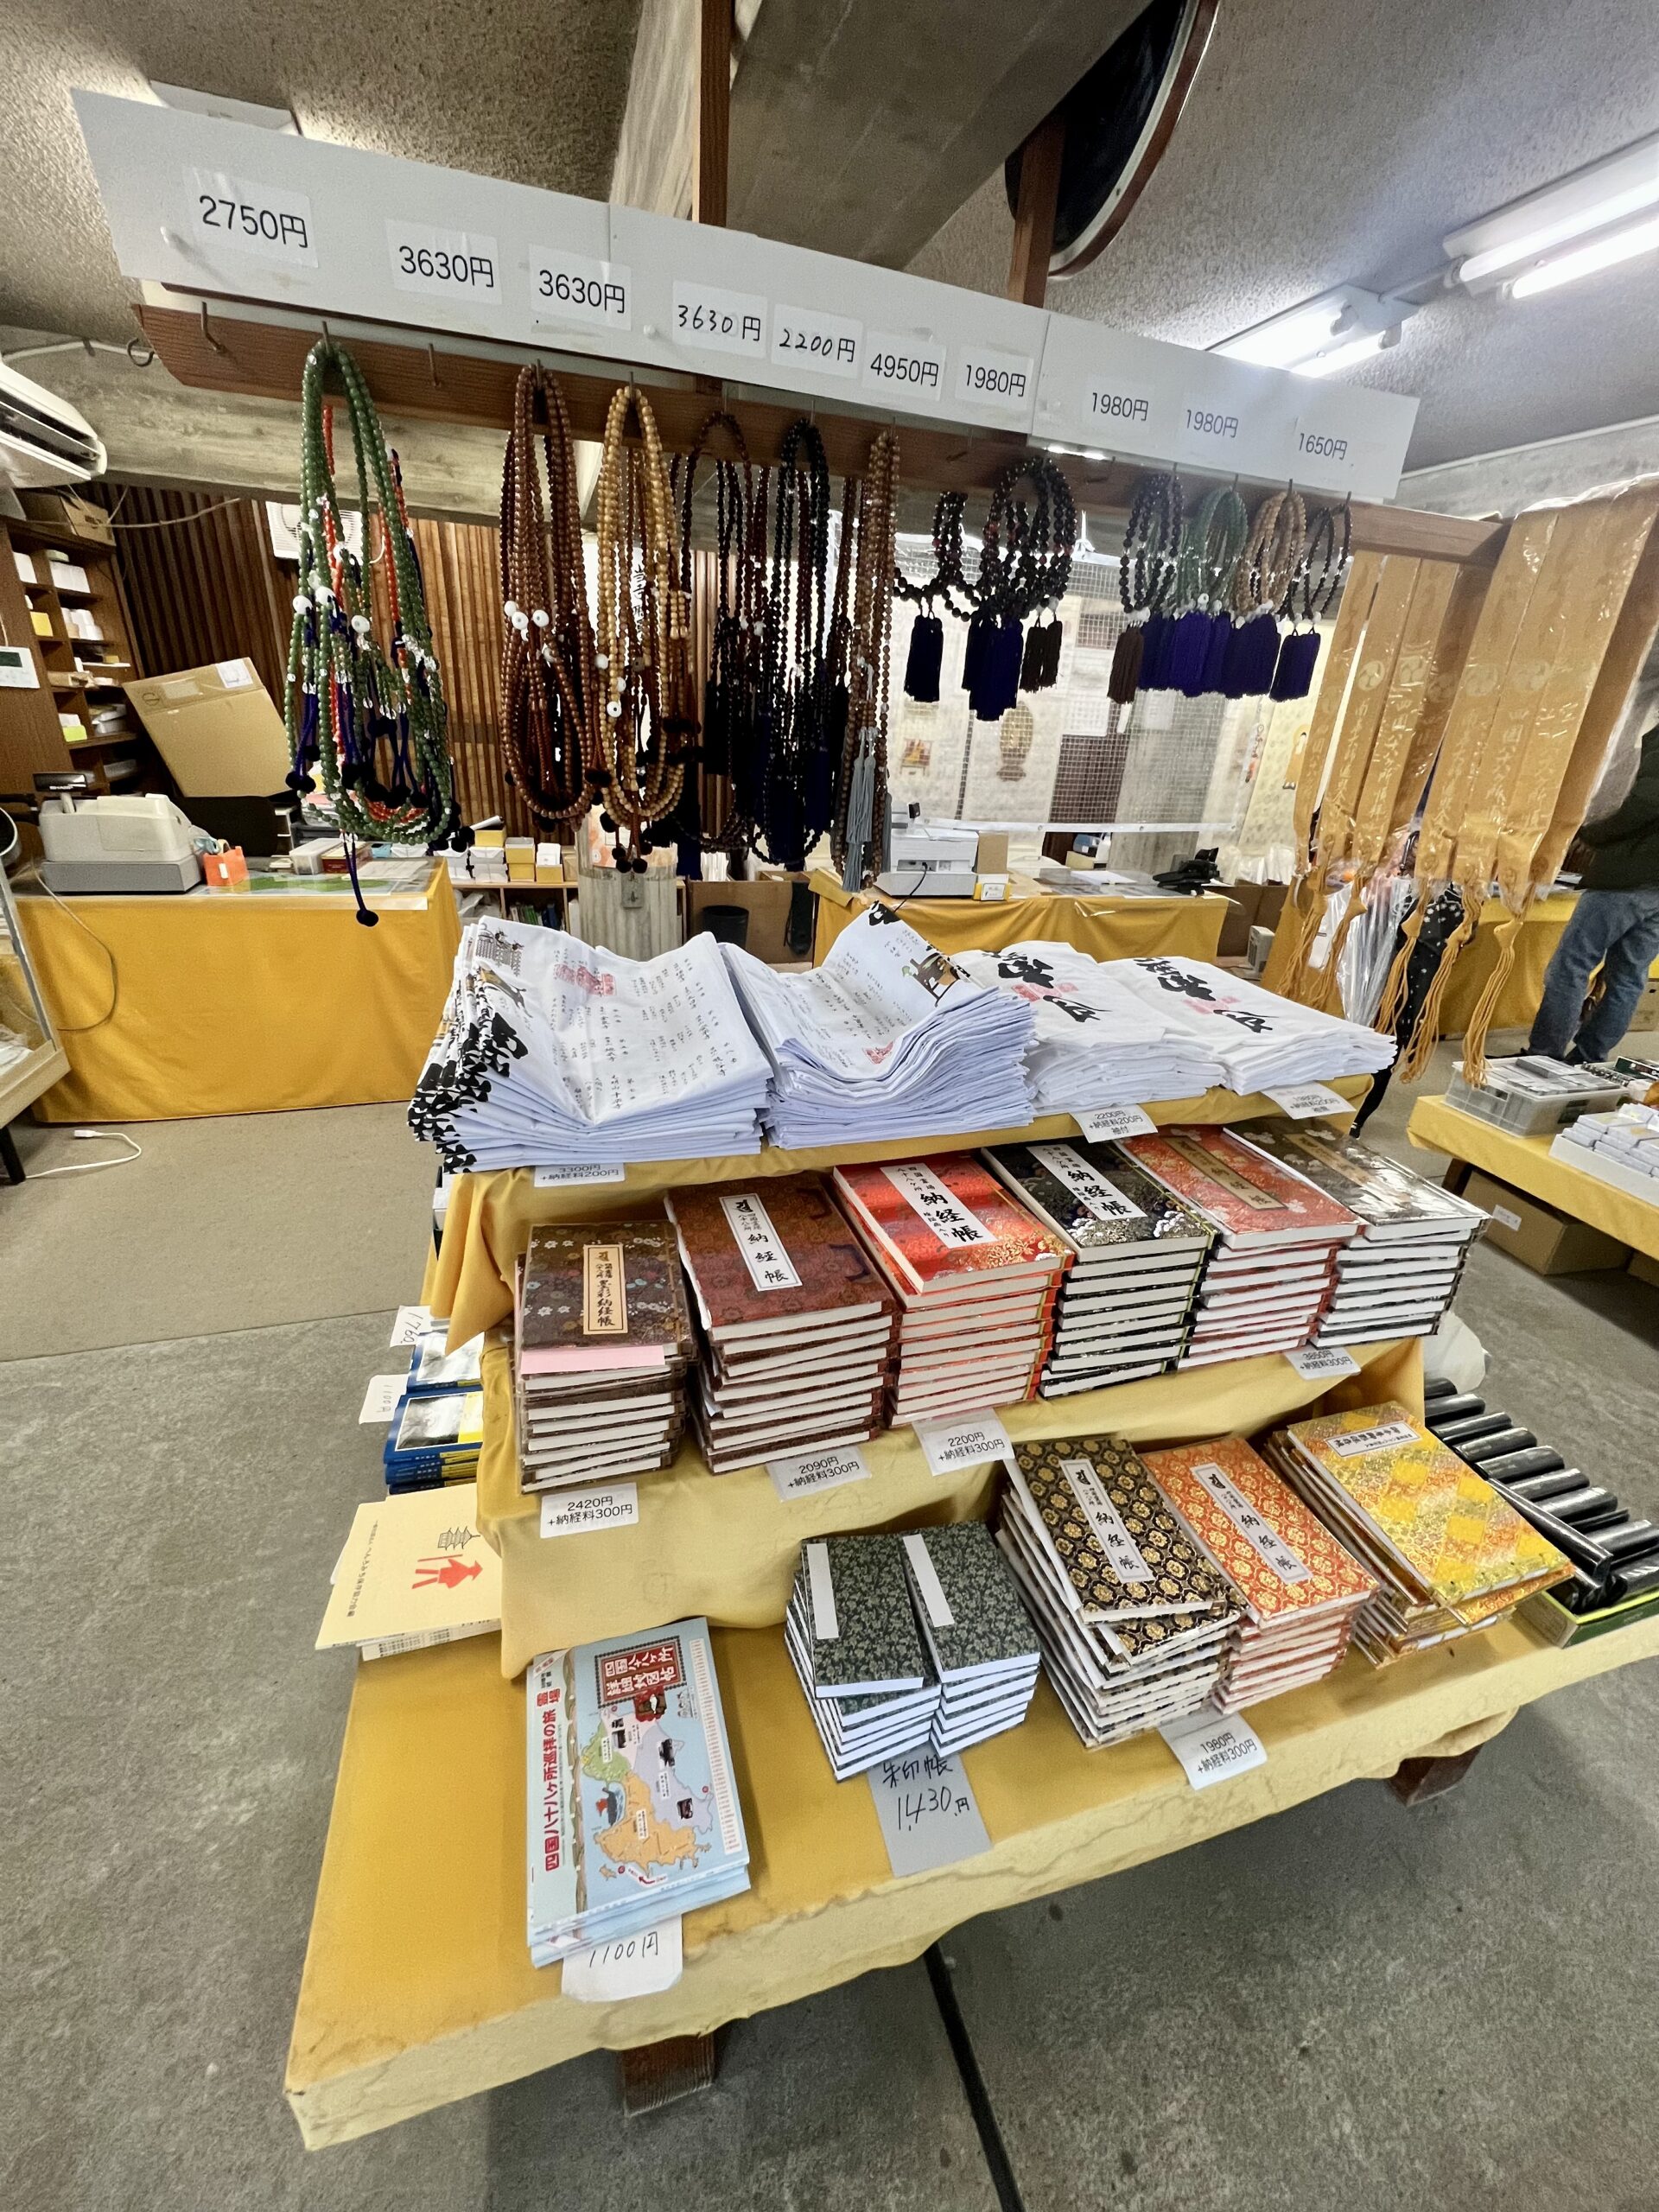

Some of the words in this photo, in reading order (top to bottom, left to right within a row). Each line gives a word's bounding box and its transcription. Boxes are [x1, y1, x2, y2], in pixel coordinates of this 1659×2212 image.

[198, 194, 308, 249] 2750円
[397, 245, 495, 289] 3630円
[537, 269, 626, 315] 3630円
[677, 303, 762, 343] 3630円
[779, 327, 856, 365] 2200円
[869, 351, 940, 388] 4950円
[963, 364, 1027, 398] 1980円
[1090, 390, 1149, 423] 1980円
[1184, 408, 1239, 440] 1980円
[1297, 431, 1349, 461] 1650円
[1094, 1110, 1127, 1120] 2200円
[558, 1163, 601, 1173] 3300円
[1066, 1169, 1133, 1216] 納経帳
[919, 1192, 984, 1243] 納経帳
[938, 1438, 1006, 1461] +納経料300円
[947, 1431, 986, 1447] 2200円
[787, 1460, 861, 1488] +納経料300円
[798, 1456, 839, 1474] 2090円
[547, 1503, 632, 1526] +納経料300円
[567, 1495, 613, 1512] 2420円
[1095, 1511, 1141, 1571] 納経帳
[1240, 1514, 1297, 1571] 納経帳
[1197, 1738, 1258, 1774] +納経料300円
[1199, 1732, 1236, 1754] 1980円
[589, 1930, 658, 1968] 1100円
